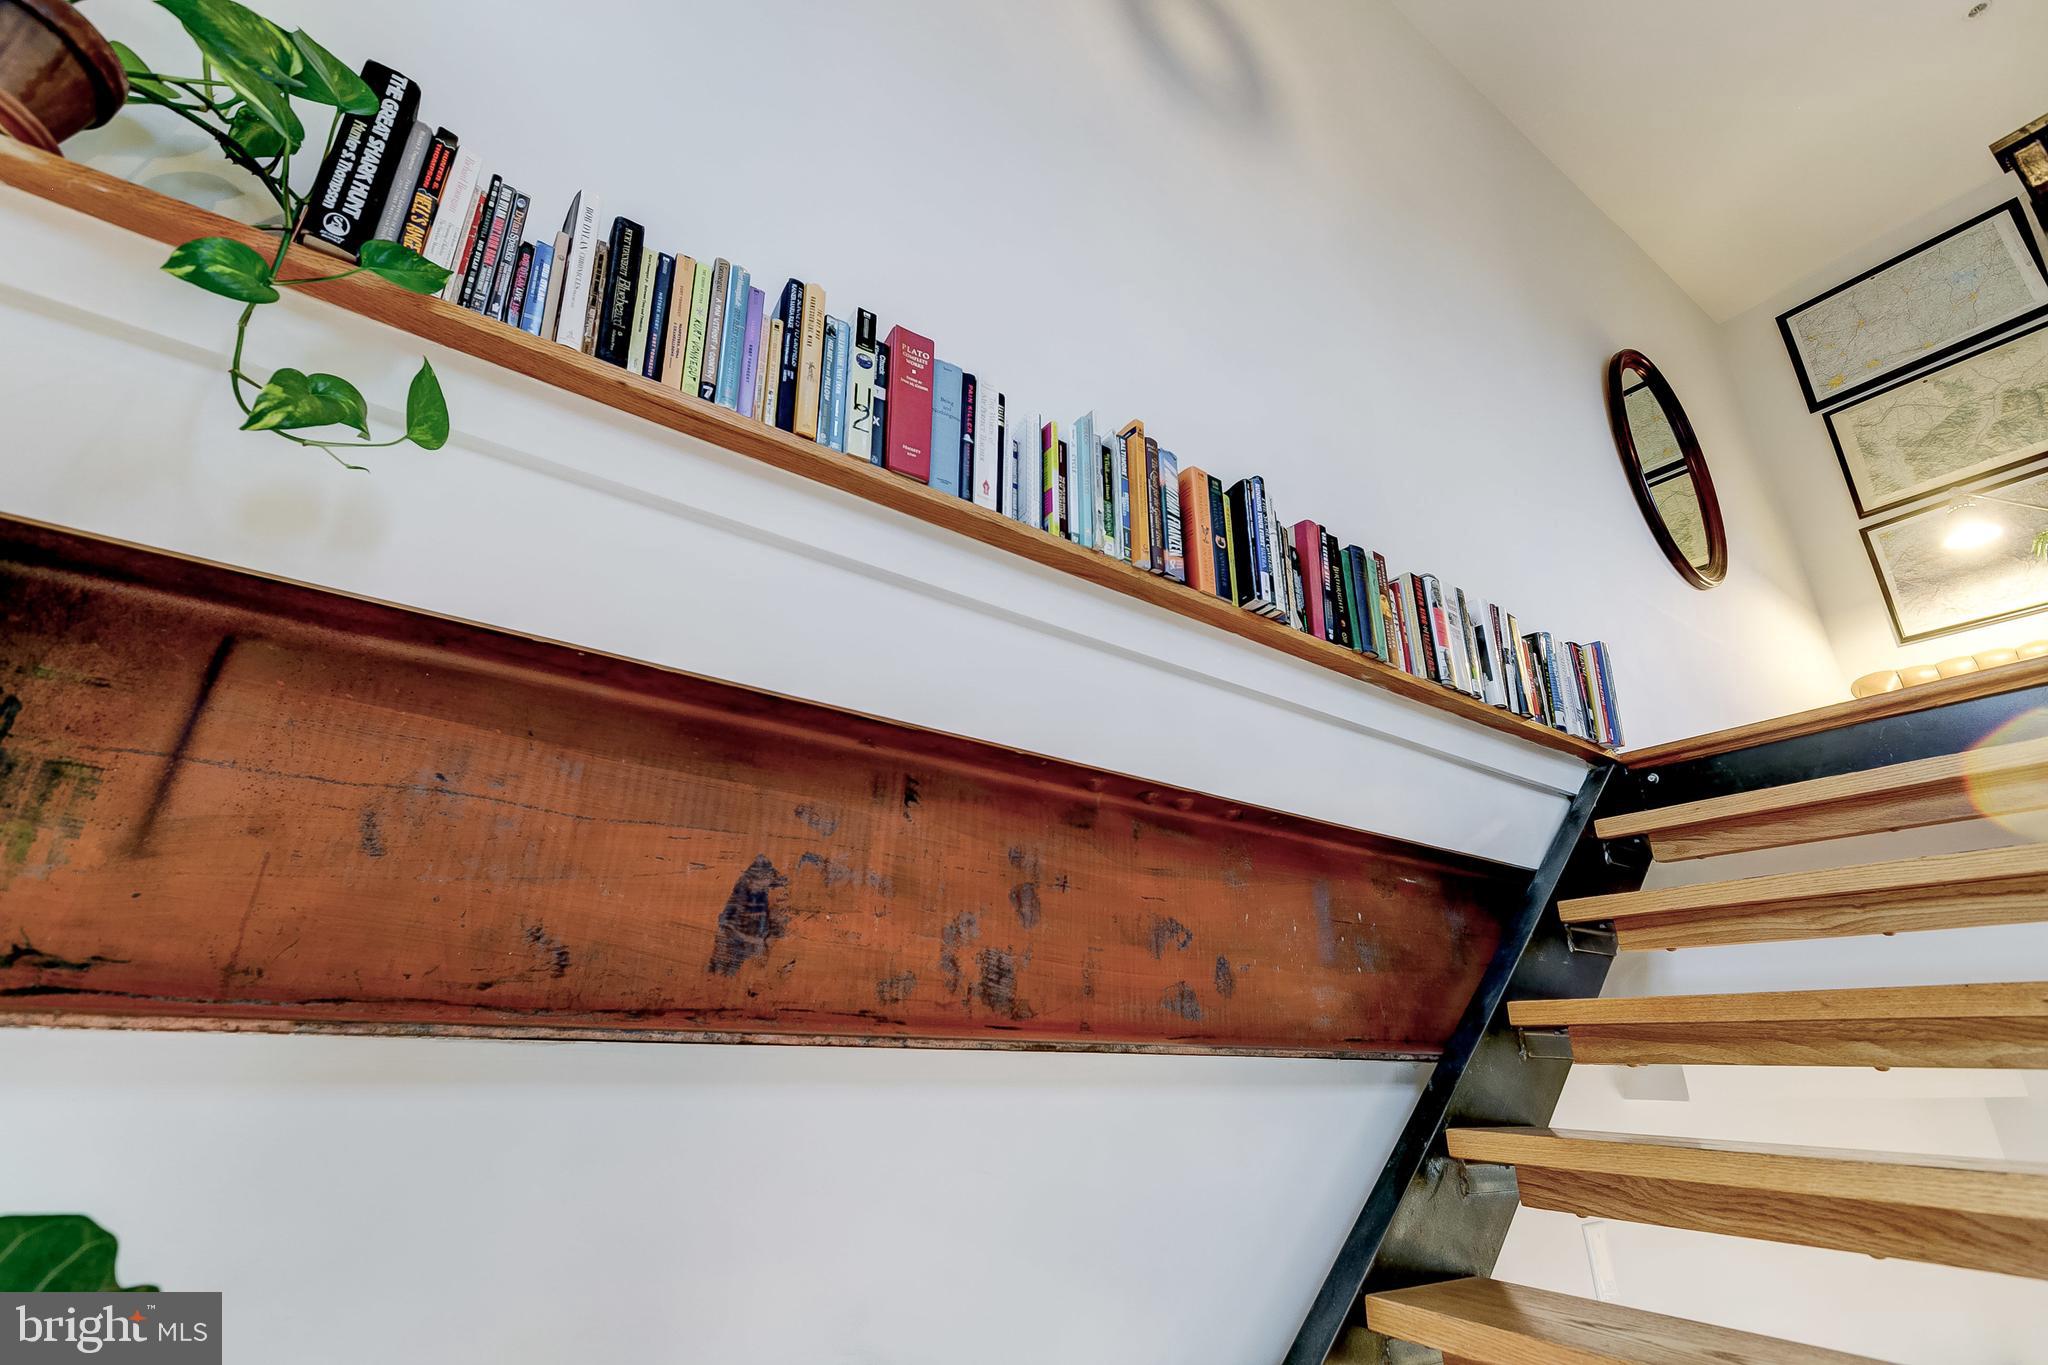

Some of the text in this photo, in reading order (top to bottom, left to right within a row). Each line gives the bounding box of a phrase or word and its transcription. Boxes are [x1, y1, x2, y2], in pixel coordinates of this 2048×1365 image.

[340, 73, 409, 220] THE GREAT SHARK HUNT
[343, 118, 367, 152] Hunter
[340, 148, 356, 161] S.
[420, 142, 443, 189] THOMPSON
[433, 149, 450, 183] HUNTER
[321, 158, 352, 210] Thompson
[496, 186, 512, 220] BOB DYLAN
[583, 206, 593, 223] BOB
[398, 191, 435, 253] HELL'S ANGE
[476, 239, 485, 252] BOB
[487, 233, 501, 250] LOOK
[502, 208, 524, 262] Dylan Speaks
[577, 222, 591, 250] DYLAN
[471, 251, 482, 271] DYLAN
[484, 248, 497, 266] BACK
[520, 252, 531, 268] BOB
[616, 243, 631, 276] VONNEGUT
[514, 266, 528, 288] DYLAN
[540, 262, 550, 279] BOB
[714, 262, 726, 293] Vonnegut
[512, 286, 524, 302] LIVE
[535, 278, 547, 302] DYLAN
[610, 276, 631, 329] Bluebeard
[710, 317, 719, 342] WITHOUT
[786, 315, 794, 328] RILKE
[686, 317, 703, 382] KURT VONNEGUT
[901, 343, 930, 359] PLATO
[902, 351, 928, 365] COMPLETE
[706, 351, 715, 378] COUNTRY
[905, 357, 924, 369] WORKS
[823, 376, 831, 400] PILLOW
[1254, 483, 1263, 511] RUNNING
[1167, 514, 1182, 557] FRANZEN
[1419, 607, 1427, 625] KING
